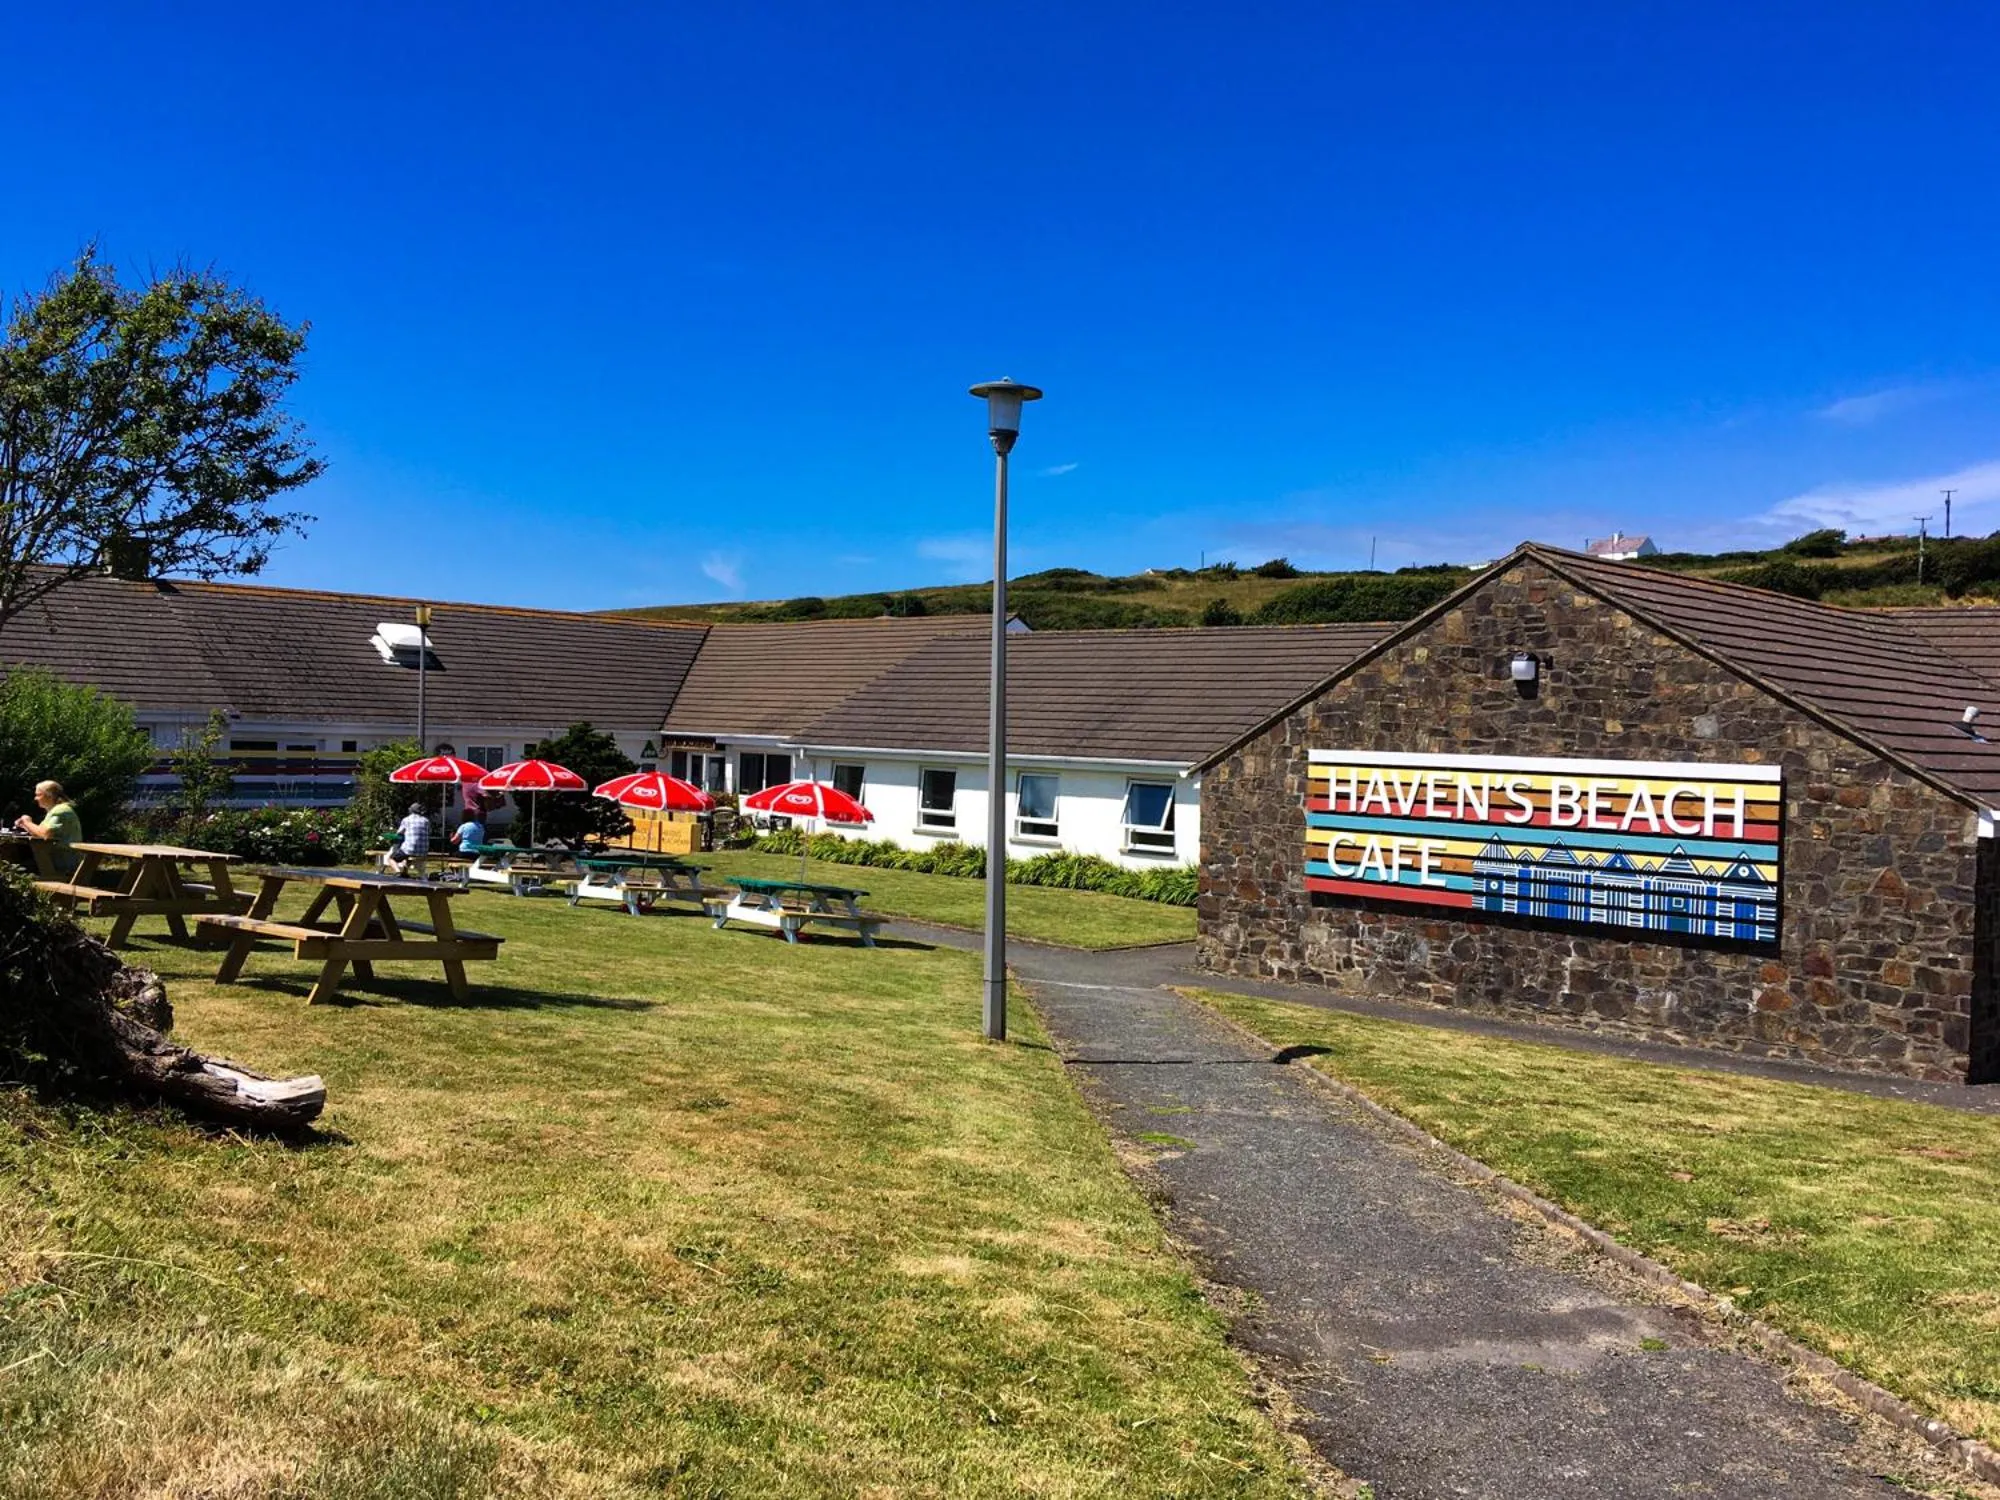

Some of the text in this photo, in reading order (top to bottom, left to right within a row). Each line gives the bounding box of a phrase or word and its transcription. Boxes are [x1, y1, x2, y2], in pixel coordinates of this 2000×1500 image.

[1328, 768, 1745, 838] HAVEN'S BEACH
[1327, 832, 1446, 887] CAFE
